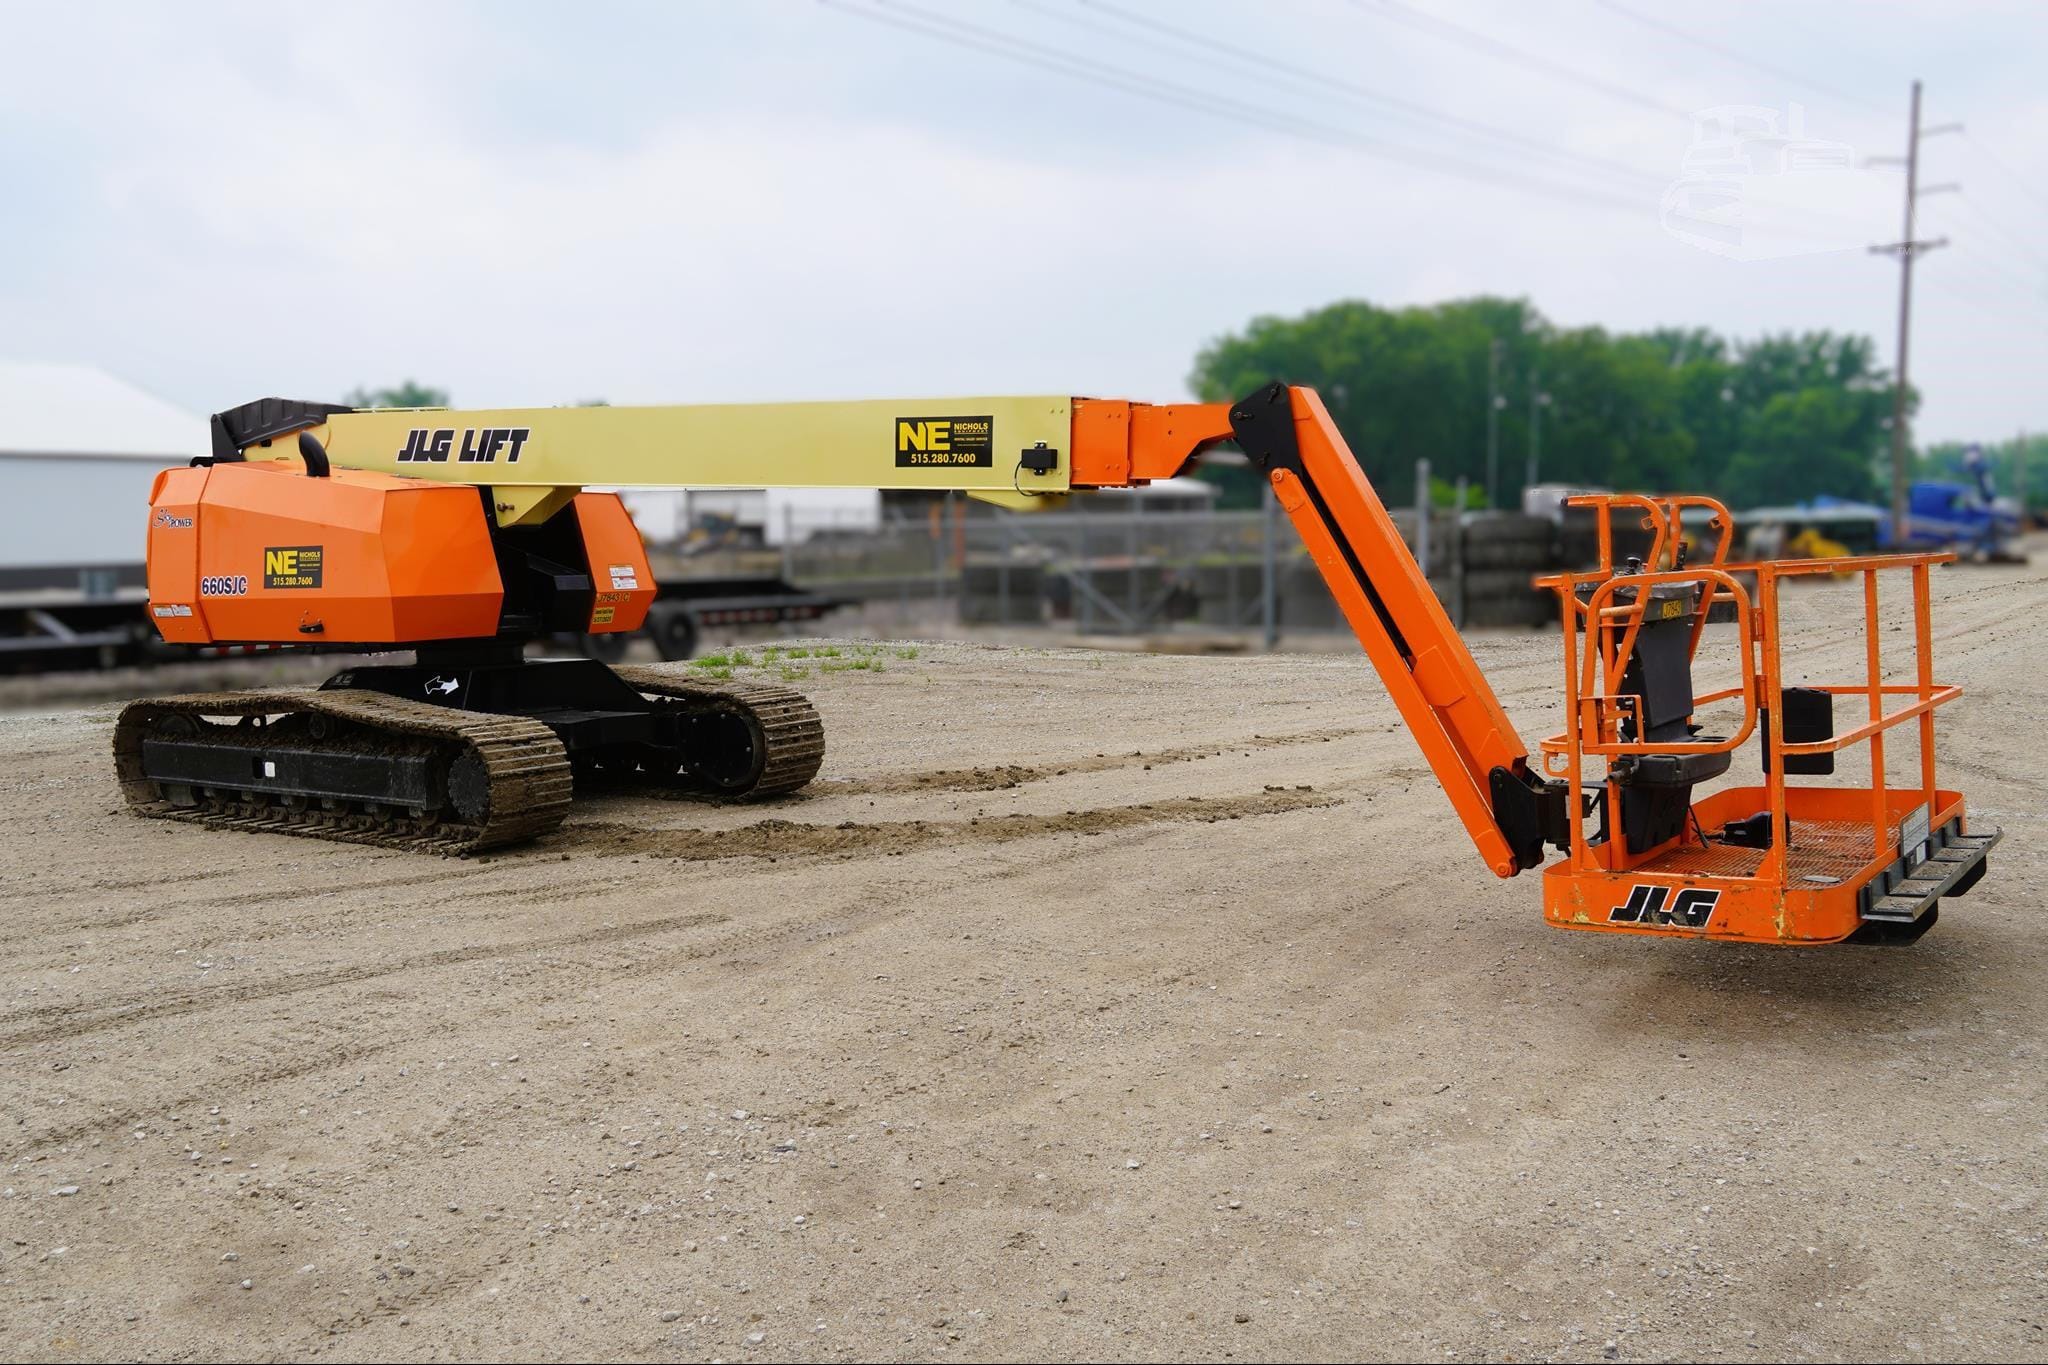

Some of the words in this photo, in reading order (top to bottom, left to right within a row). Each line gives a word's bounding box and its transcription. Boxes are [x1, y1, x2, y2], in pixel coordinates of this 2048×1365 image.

[899, 421, 950, 451] NE
[954, 422, 988, 430] NICHOLS
[396, 428, 455, 462] JLG
[457, 427, 530, 462] LIFT
[910, 453, 976, 464] 515.280.7600
[266, 550, 298, 575] NE
[201, 576, 247, 595] 660SJC
[1607, 885, 1721, 928] JLG
